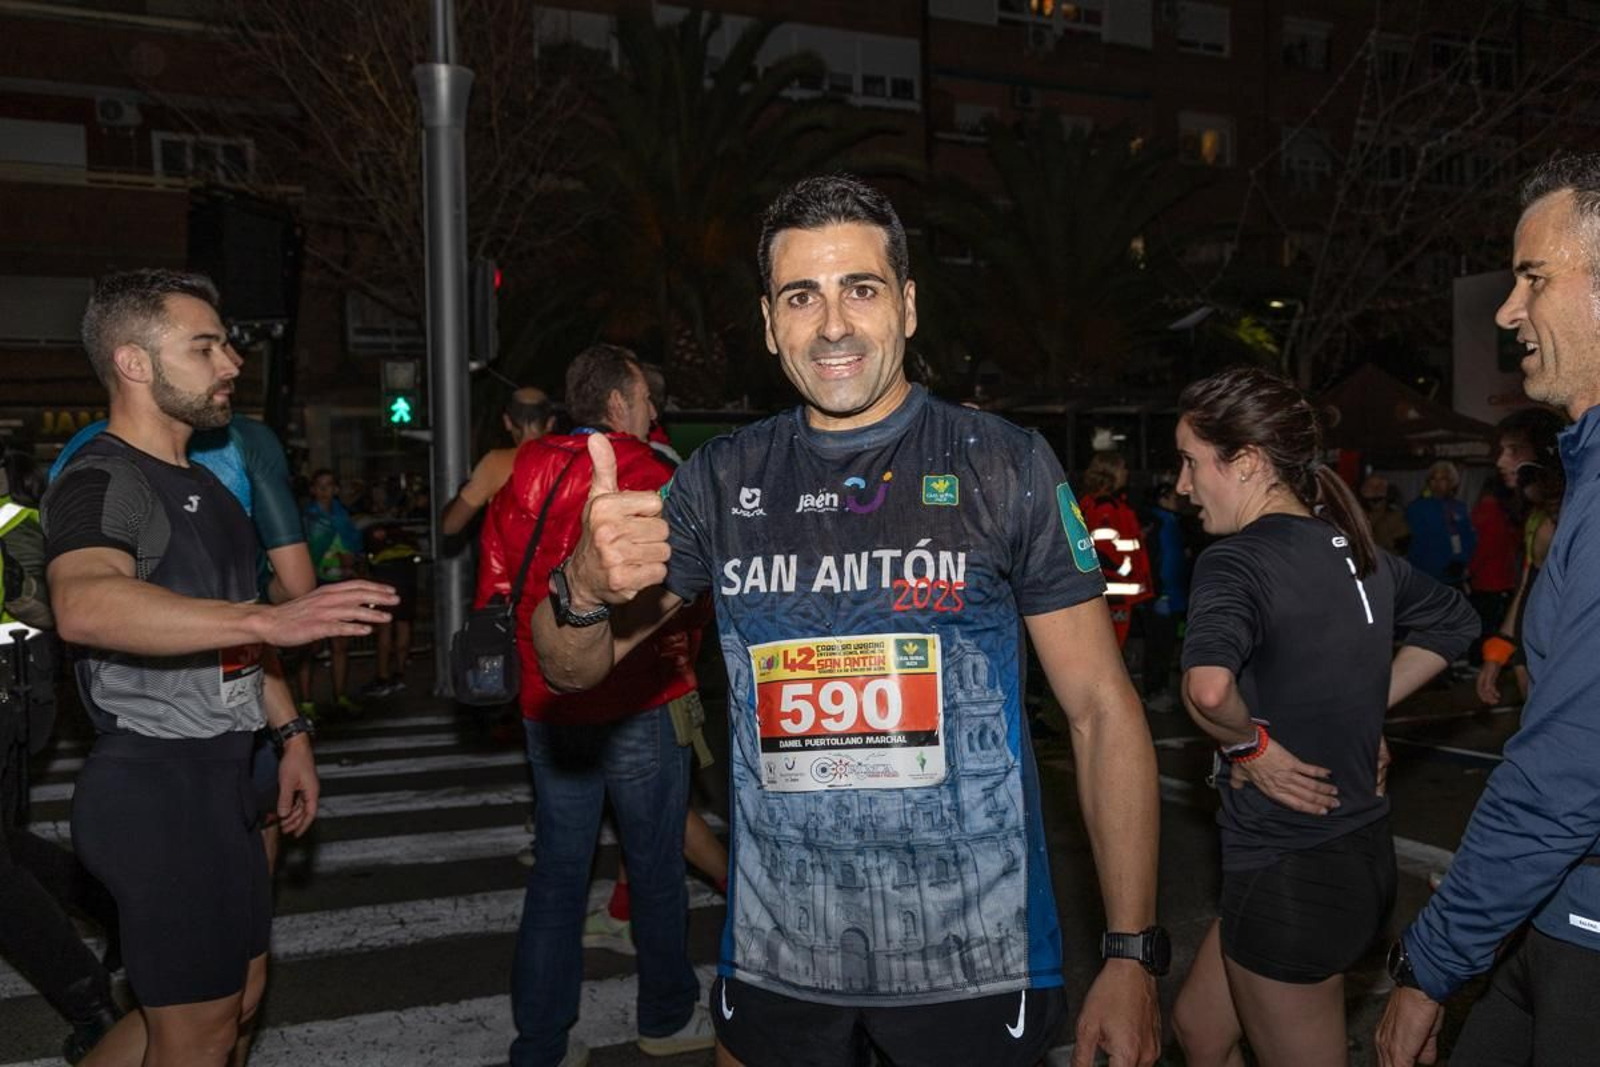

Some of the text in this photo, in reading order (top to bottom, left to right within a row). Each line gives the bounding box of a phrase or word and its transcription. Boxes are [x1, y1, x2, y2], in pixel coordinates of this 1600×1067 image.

[720, 538, 967, 596] SAN ANTÓN
[892, 577, 967, 612] 2025
[782, 646, 816, 673] 42
[816, 658, 841, 670] SAN
[779, 678, 902, 734] 590
[779, 735, 907, 748] DANIEL PUERTOLLANO MARCHAL
